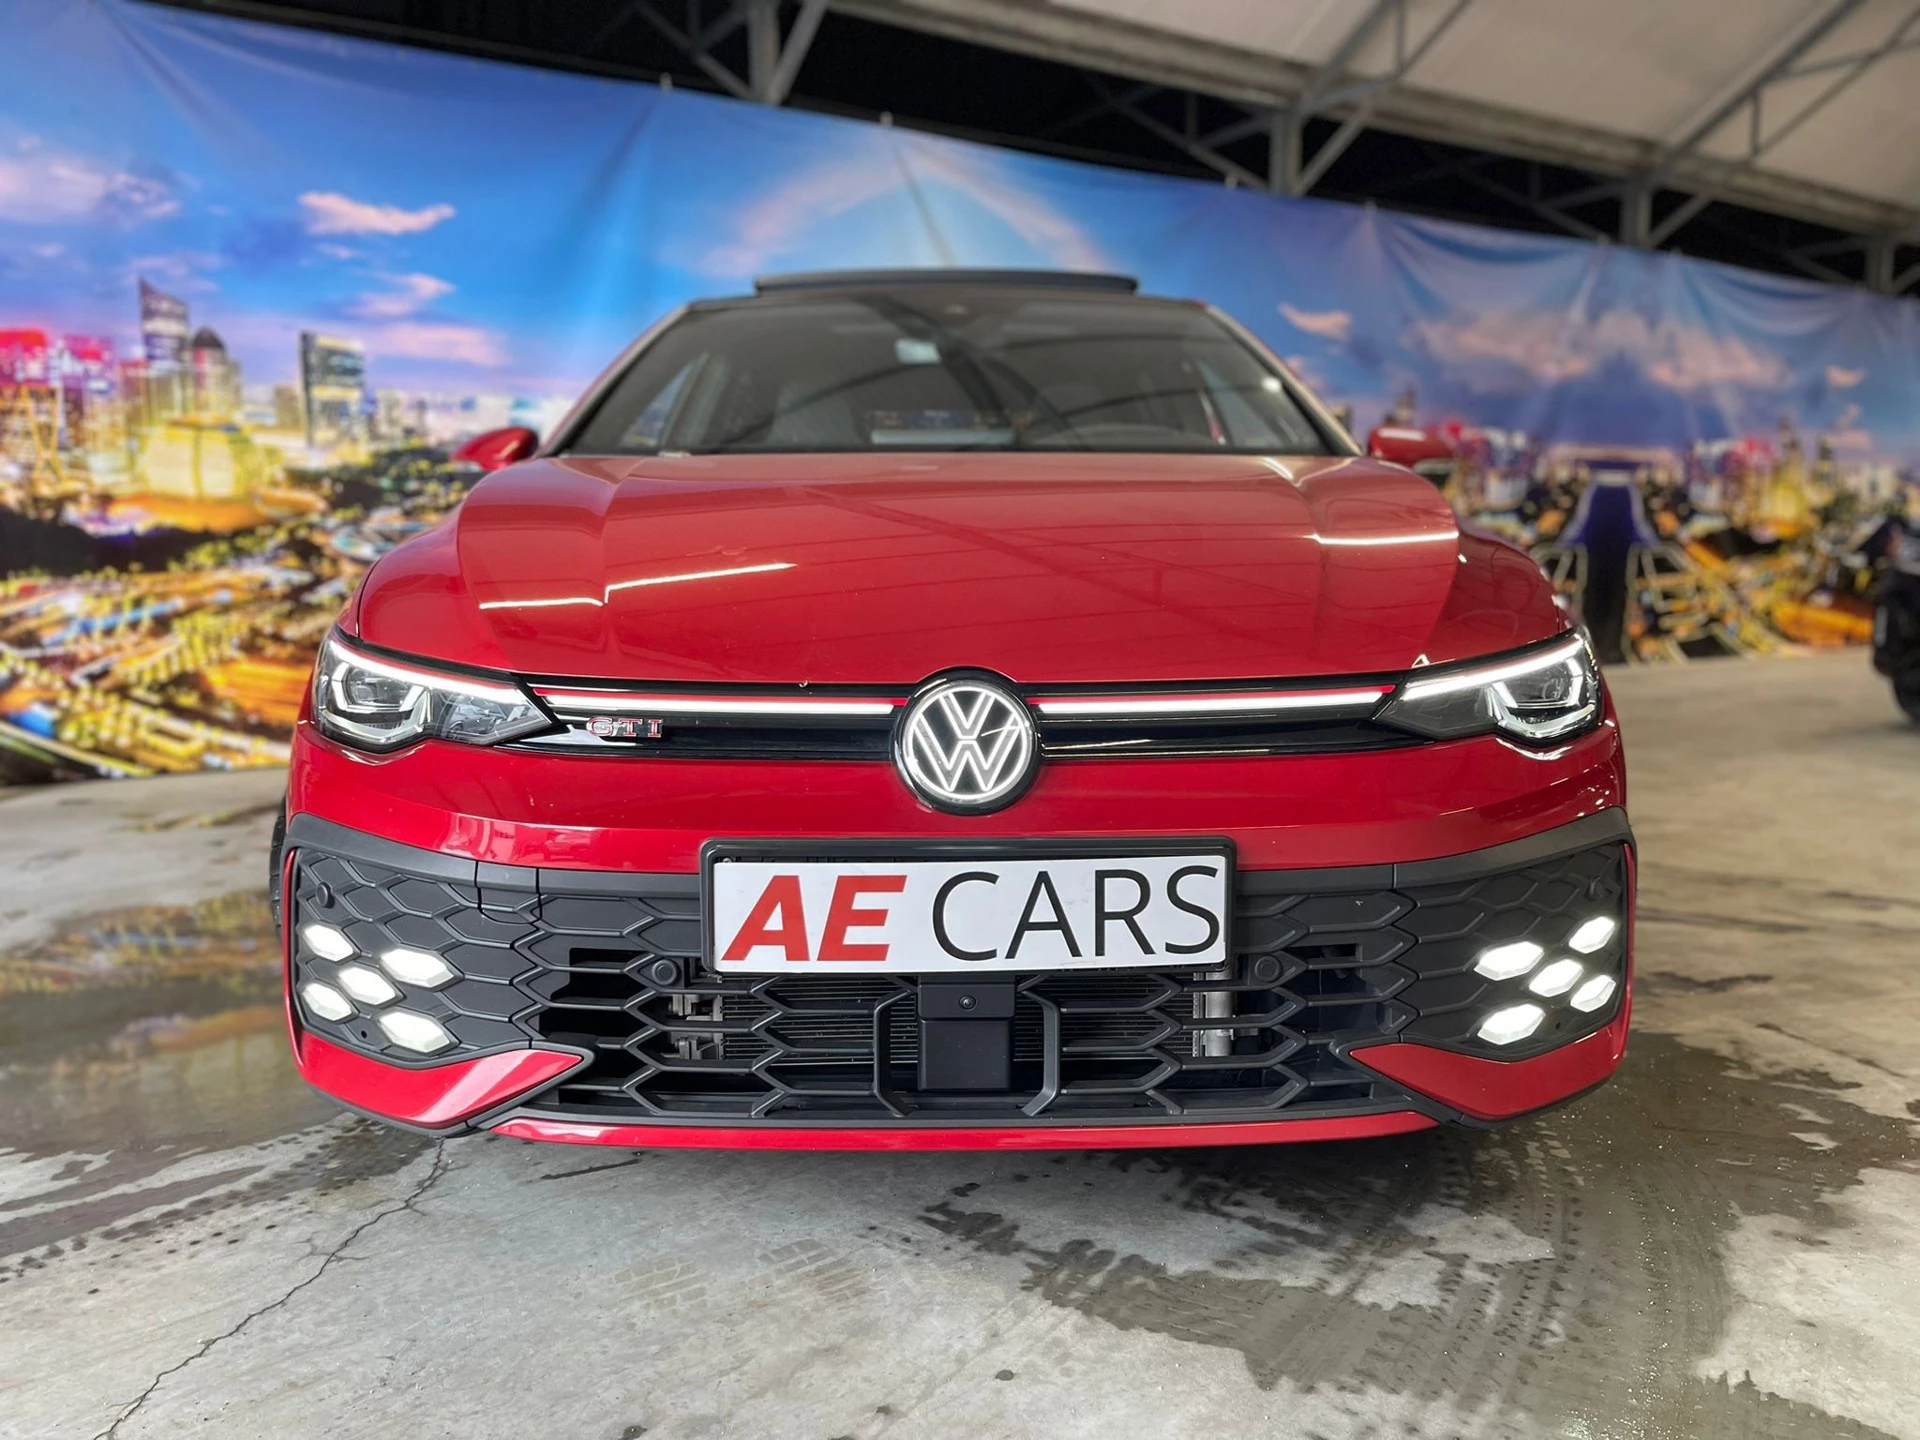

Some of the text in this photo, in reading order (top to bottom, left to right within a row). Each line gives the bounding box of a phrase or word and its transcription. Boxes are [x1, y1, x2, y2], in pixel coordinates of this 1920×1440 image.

[586, 717, 662, 738] GTI
[911, 689, 1023, 794] VW
[722, 866, 1220, 962] AE CARS
